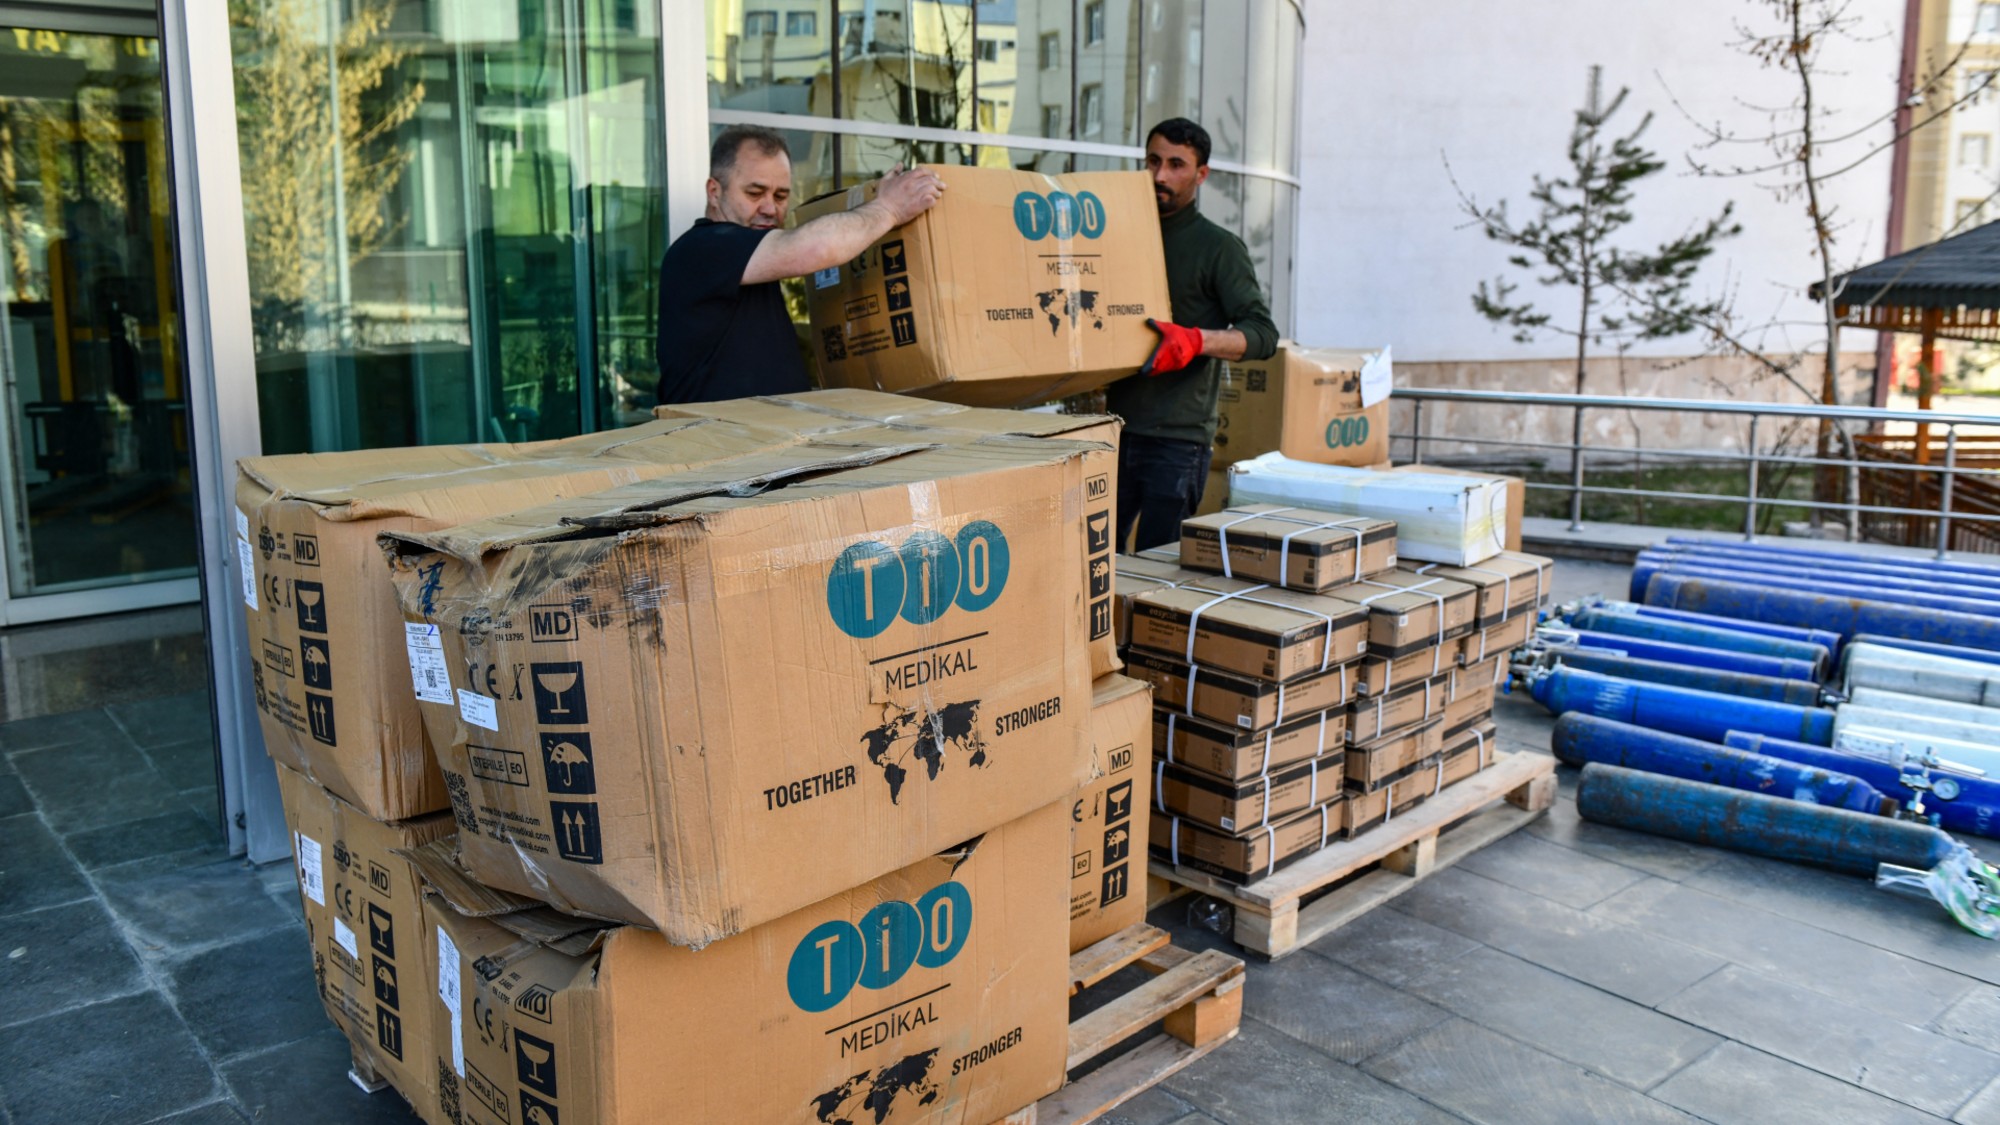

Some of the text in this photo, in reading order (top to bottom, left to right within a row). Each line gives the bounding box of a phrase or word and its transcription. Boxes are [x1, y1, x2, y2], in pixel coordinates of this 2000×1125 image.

[986, 304, 1145, 321] TOGETHER STRONGER
[1088, 478, 1107, 497] MD
[295, 538, 316, 560] MD
[533, 611, 571, 635] MD
[886, 648, 977, 694] MEDİKAL
[996, 697, 1061, 736] STRONGER
[473, 756, 522, 774] STERILE EO
[1111, 749, 1131, 770] MD
[764, 765, 856, 810] TOGETHER
[1077, 860, 1087, 869] EO
[371, 867, 388, 891] MD
[518, 989, 547, 1015] MD
[841, 1002, 939, 1058] MEDİKAL
[952, 1026, 1022, 1076] STRONGER
[468, 1072, 506, 1112] STERILE EO
